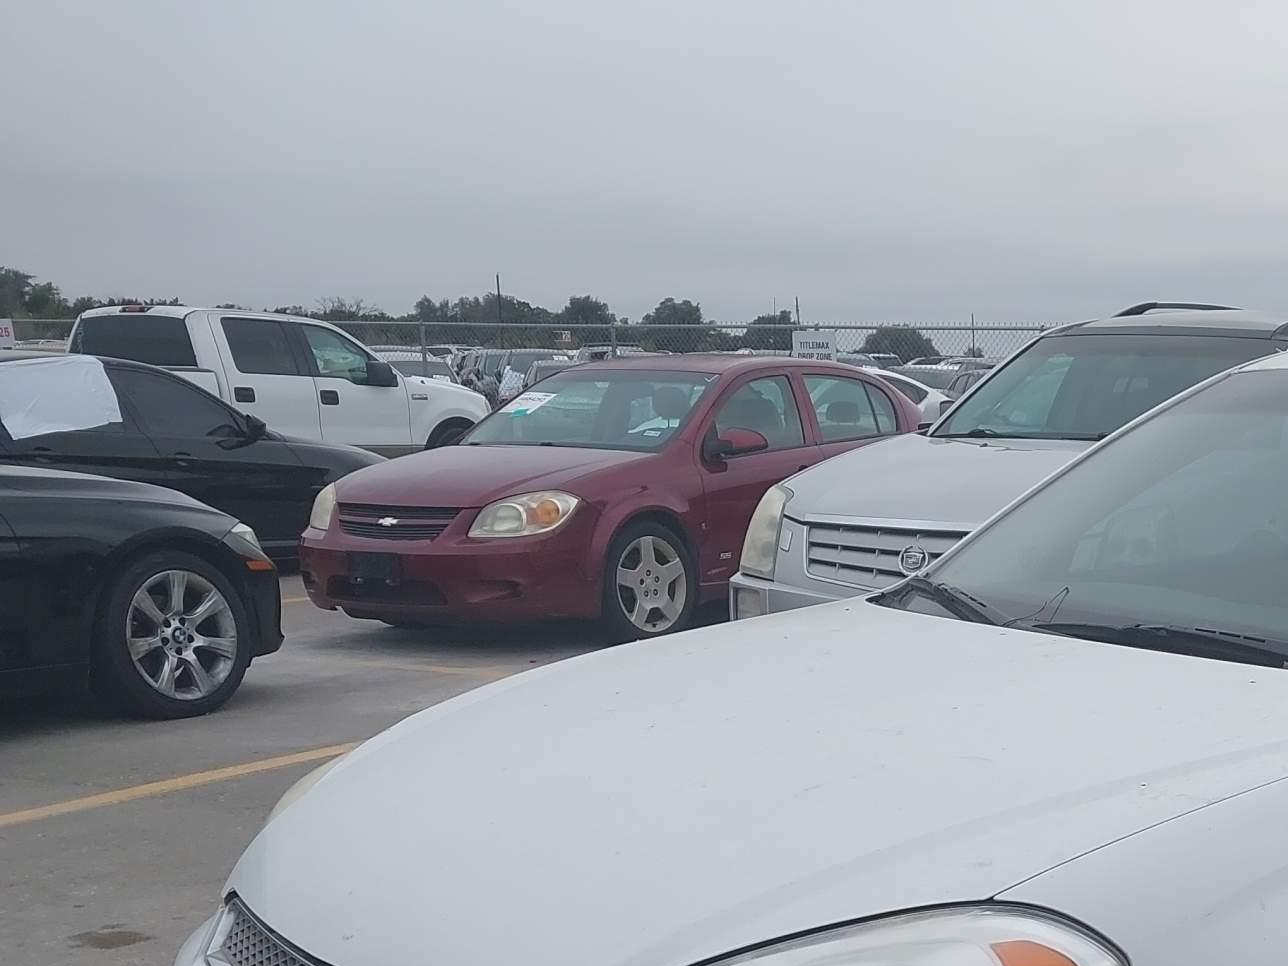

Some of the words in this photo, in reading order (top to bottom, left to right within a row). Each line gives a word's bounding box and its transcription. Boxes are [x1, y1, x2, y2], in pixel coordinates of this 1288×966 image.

[800, 341, 830, 350] TITLEMAX
[798, 352, 814, 360] DROP
[816, 352, 832, 360] ZONE
